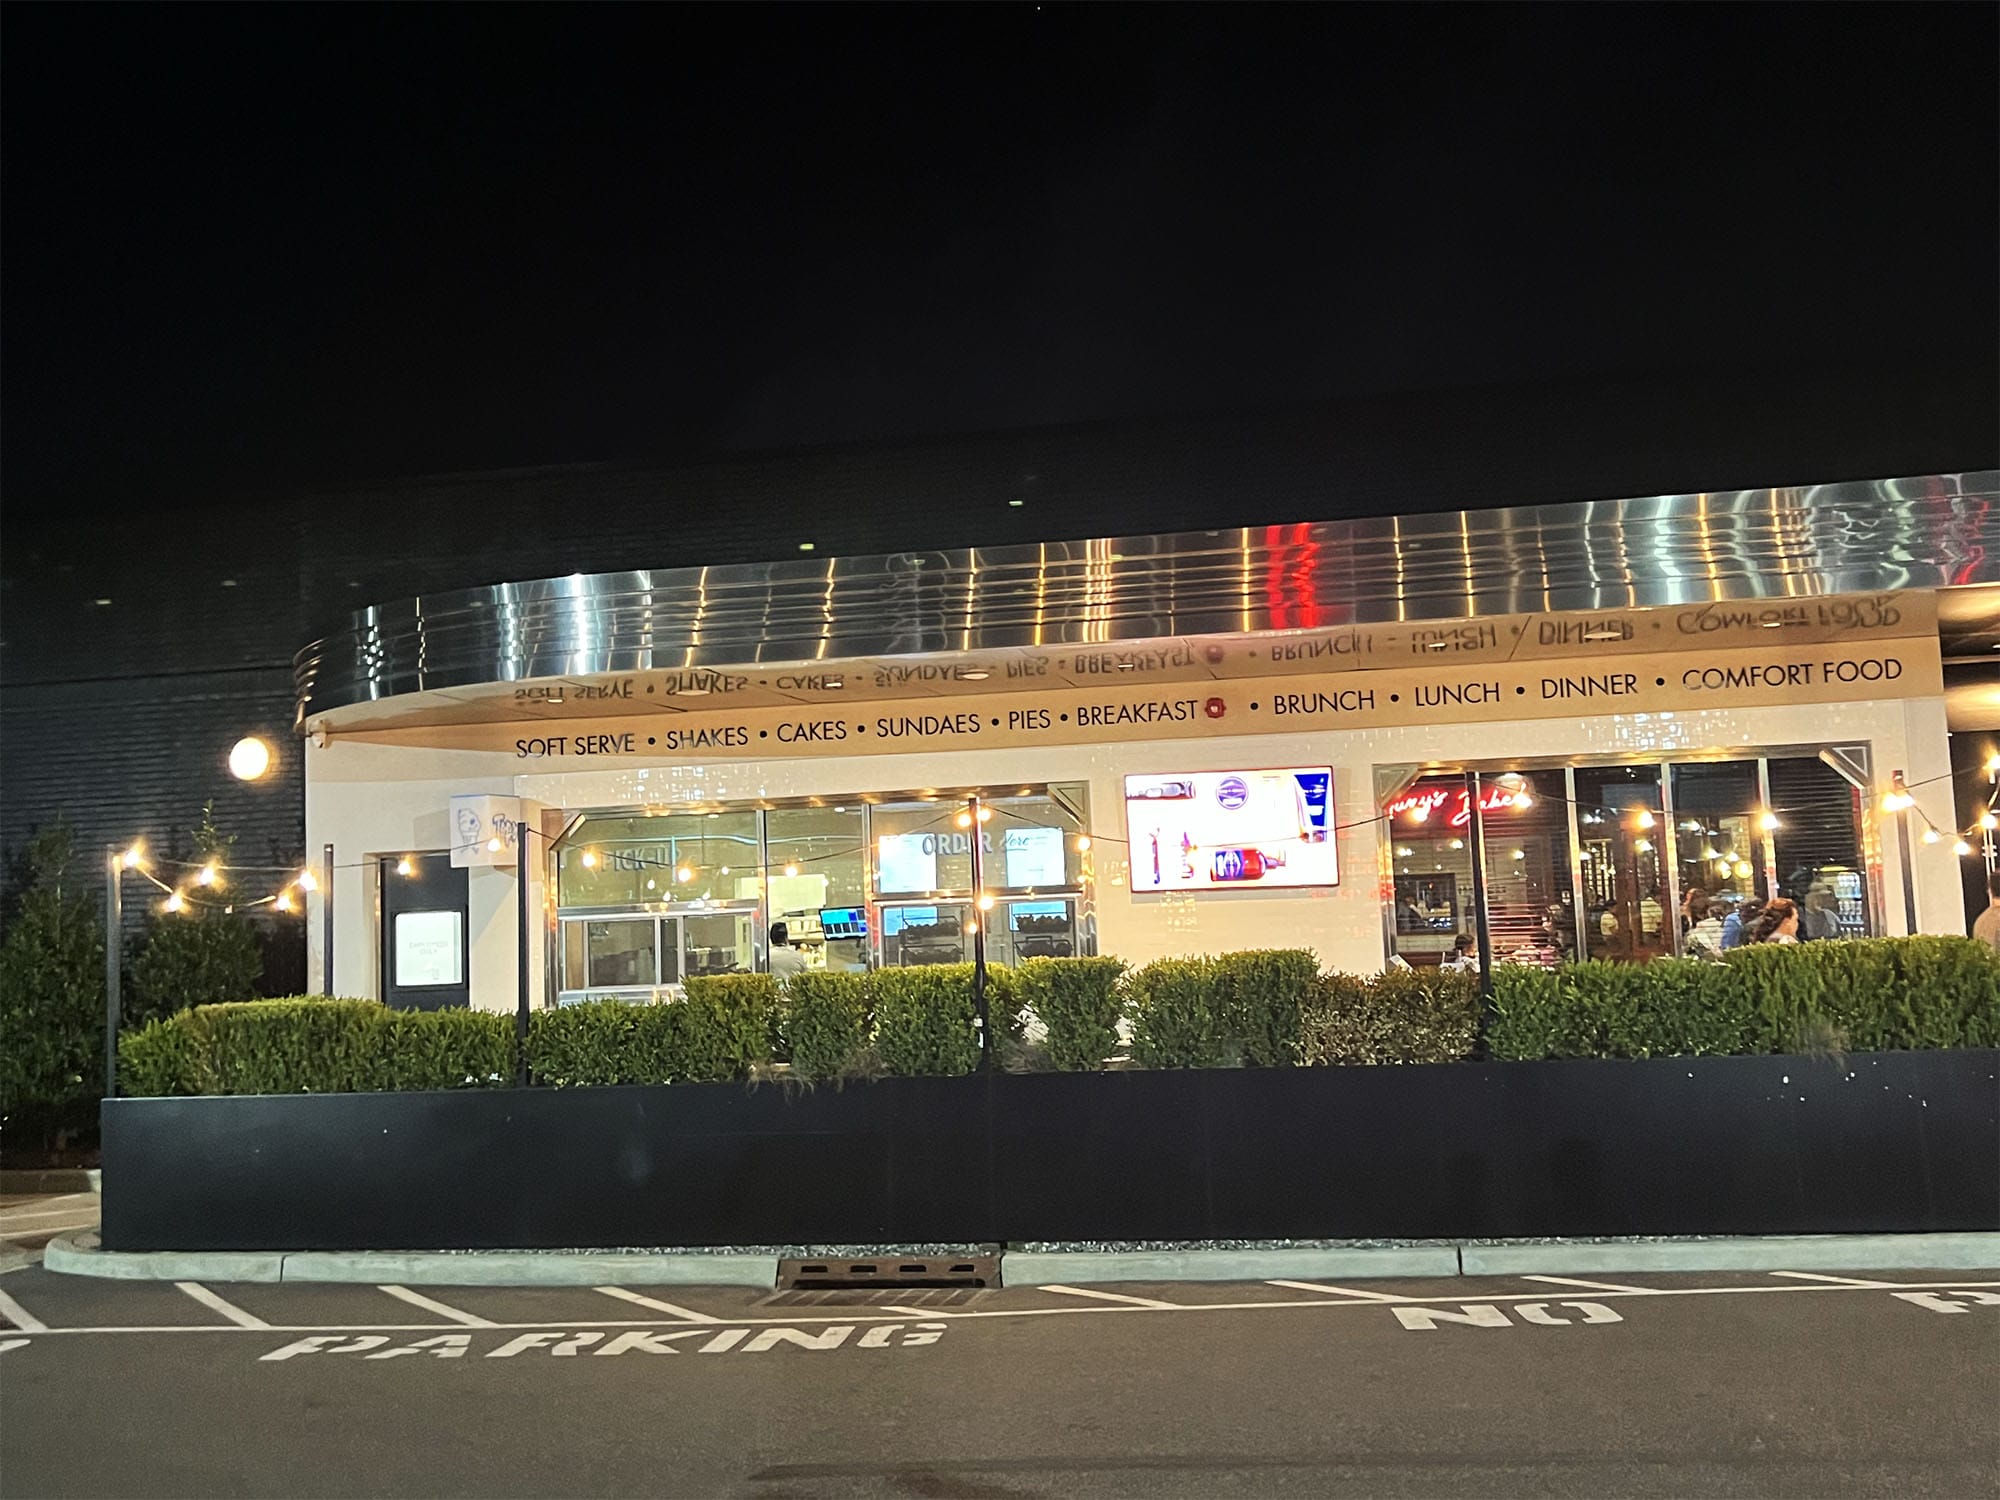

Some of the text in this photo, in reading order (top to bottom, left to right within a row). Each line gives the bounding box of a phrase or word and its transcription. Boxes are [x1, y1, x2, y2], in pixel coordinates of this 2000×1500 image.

[515, 657, 1903, 759] SOFT SERVE SHAKES CAKES SUNDAES PIES BREAKFAST BRUNCH LUNCH DINNER COMFORT FOOD
[1391, 1302, 1623, 1329] NO
[258, 1323, 948, 1361] PARKING
